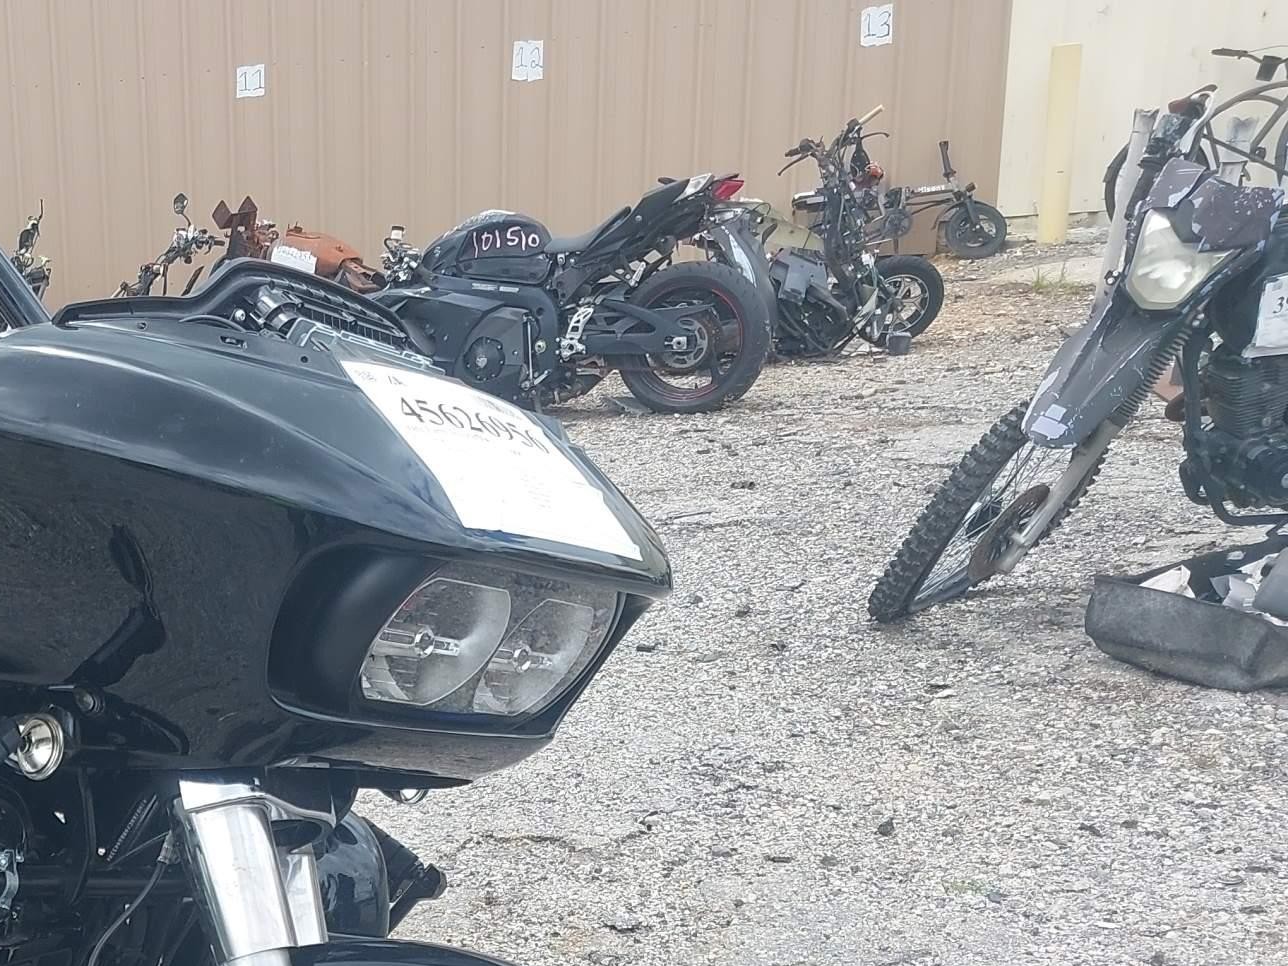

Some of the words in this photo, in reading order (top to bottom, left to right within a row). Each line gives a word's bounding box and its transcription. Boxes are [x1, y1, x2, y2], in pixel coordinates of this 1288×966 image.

[863, 11, 891, 38] 13
[514, 46, 543, 69] 12
[239, 69, 264, 91] 11
[472, 225, 540, 259] 101510
[399, 397, 550, 454] 45626956
